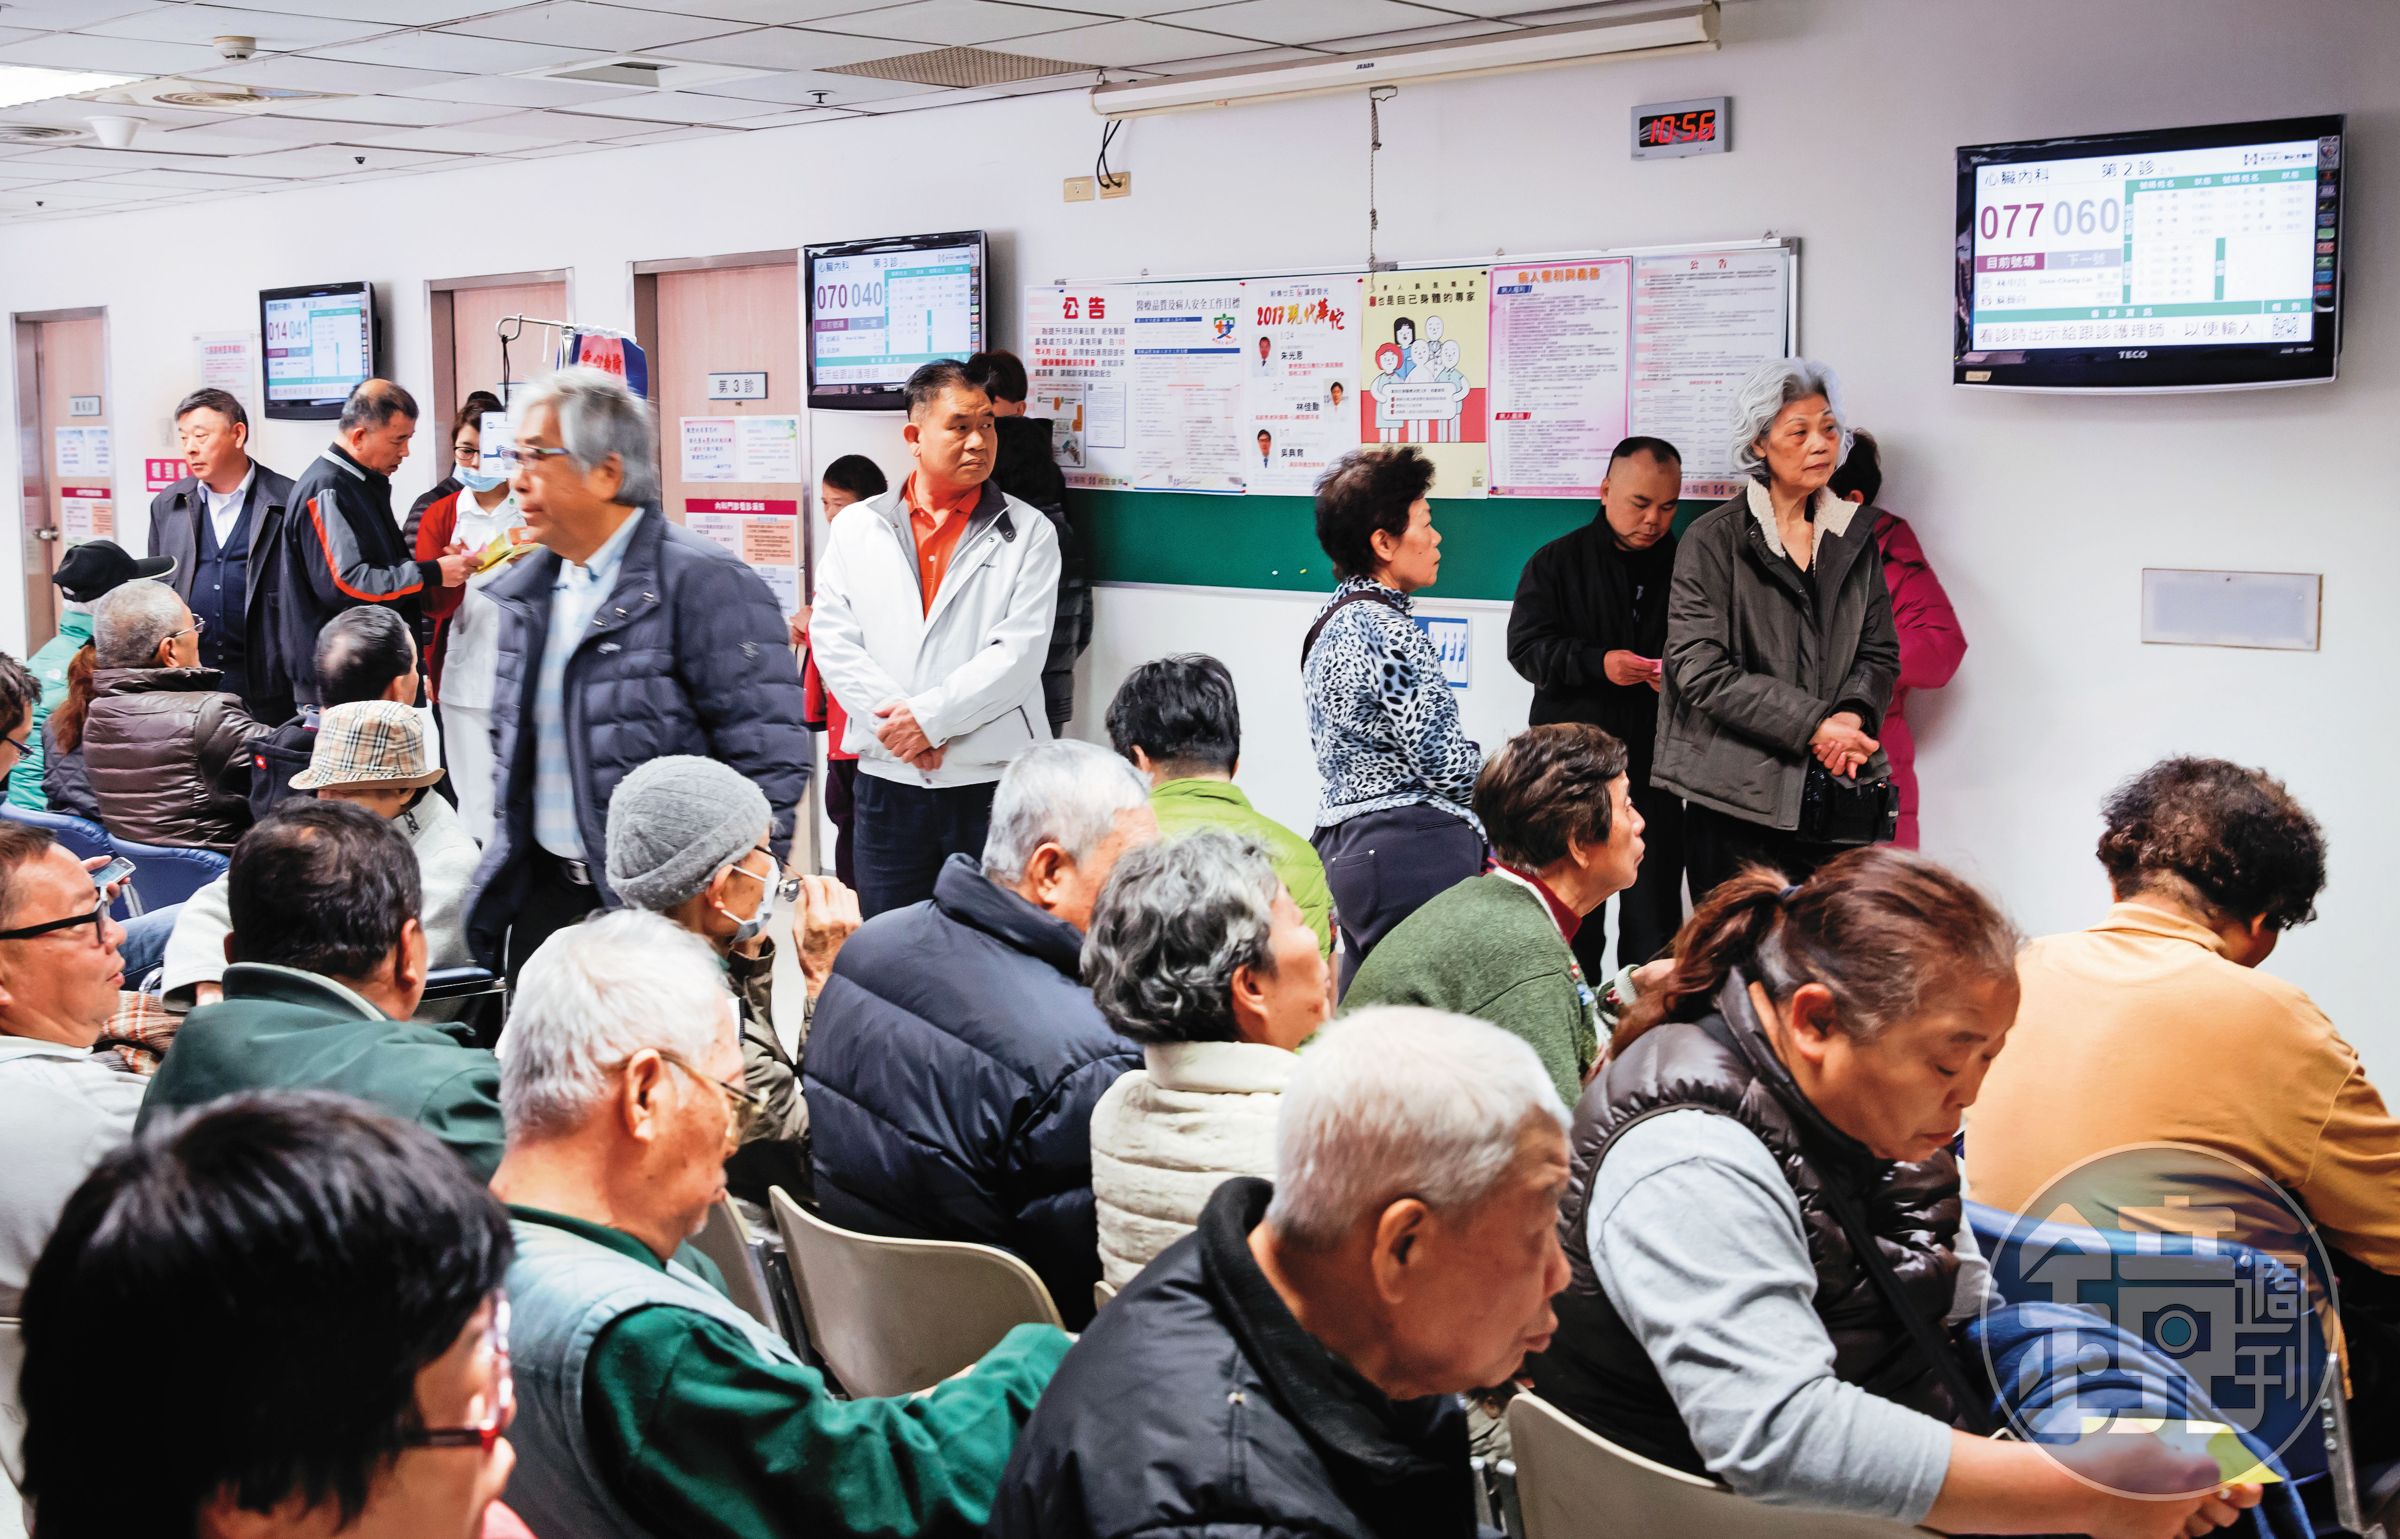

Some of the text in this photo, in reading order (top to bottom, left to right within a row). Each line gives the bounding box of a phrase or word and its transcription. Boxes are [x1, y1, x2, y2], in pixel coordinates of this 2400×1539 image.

[1649, 111, 1715, 144] 10:56
[1985, 168, 2049, 186] 心臟內科
[1980, 202, 2045, 240] 077
[2053, 198, 2120, 236] 060
[1986, 254, 2037, 270] 目前號碼
[817, 281, 883, 310] 070 040
[1136, 297, 1240, 312] 醫療品質及病人安全工作目標
[1062, 296, 1106, 319] 公告
[268, 322, 288, 341] 014
[2118, 350, 2149, 360] TECO
[718, 379, 755, 393] 第3診
